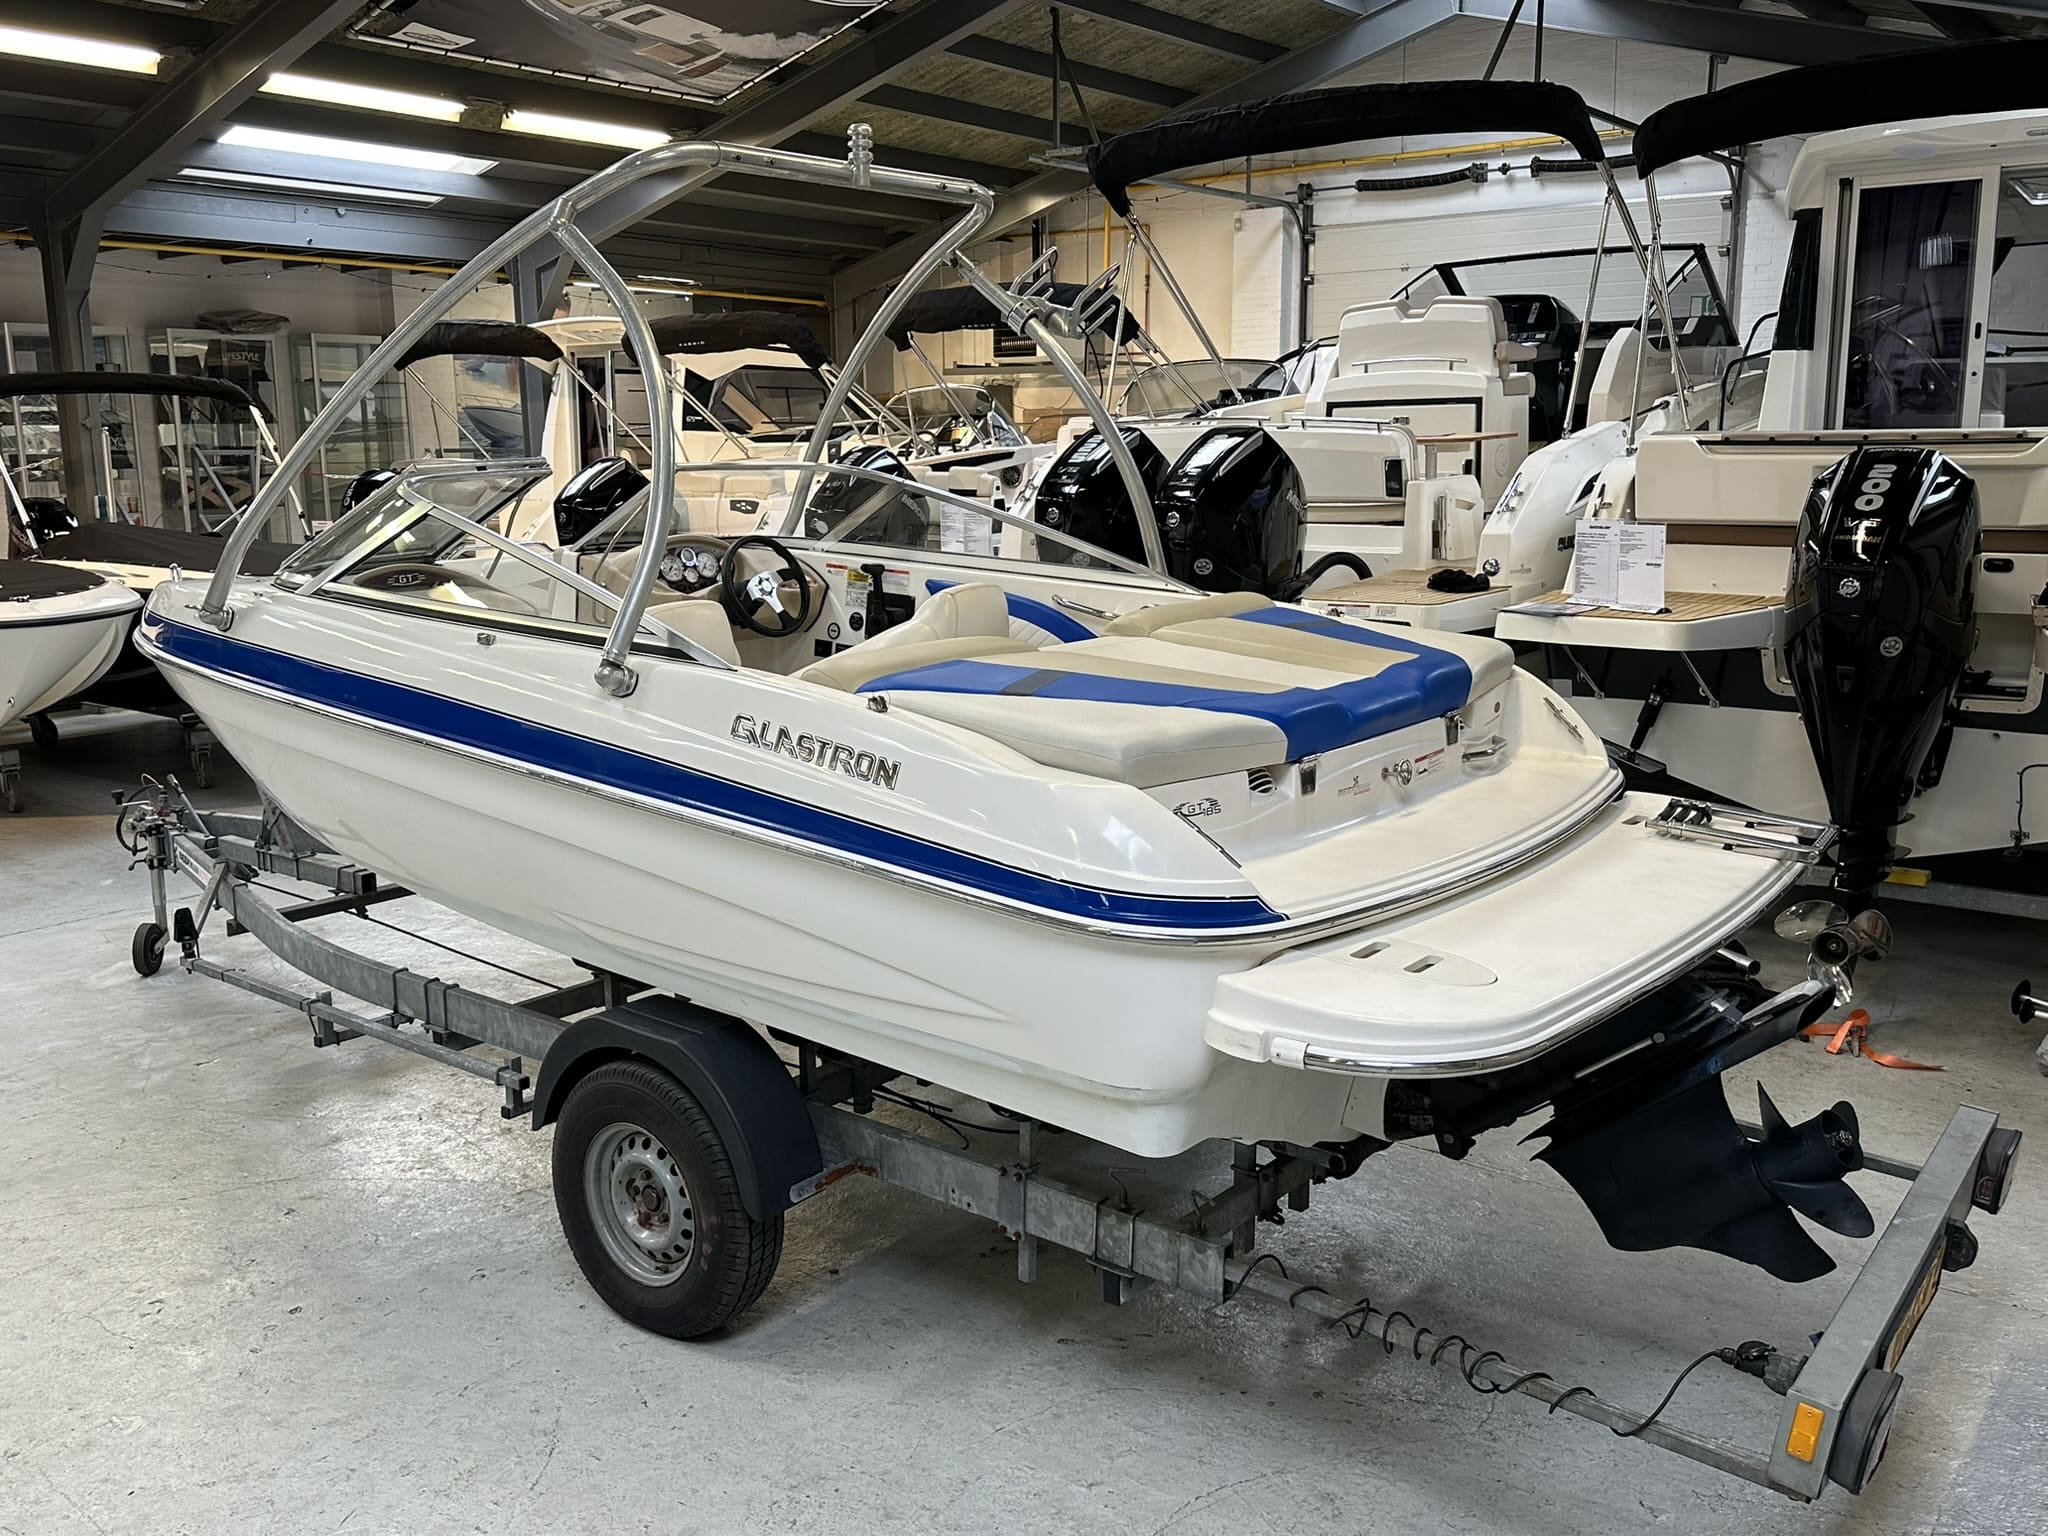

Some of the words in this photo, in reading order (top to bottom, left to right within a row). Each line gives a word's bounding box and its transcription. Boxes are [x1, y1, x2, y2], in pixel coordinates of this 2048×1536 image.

[343, 480, 358, 506] 150
[1854, 463, 1898, 512] 200
[399, 574, 413, 584] GT
[730, 712, 902, 791] GLASTRON
[1187, 802, 1204, 814] GT
[1203, 804, 1222, 817] 185
